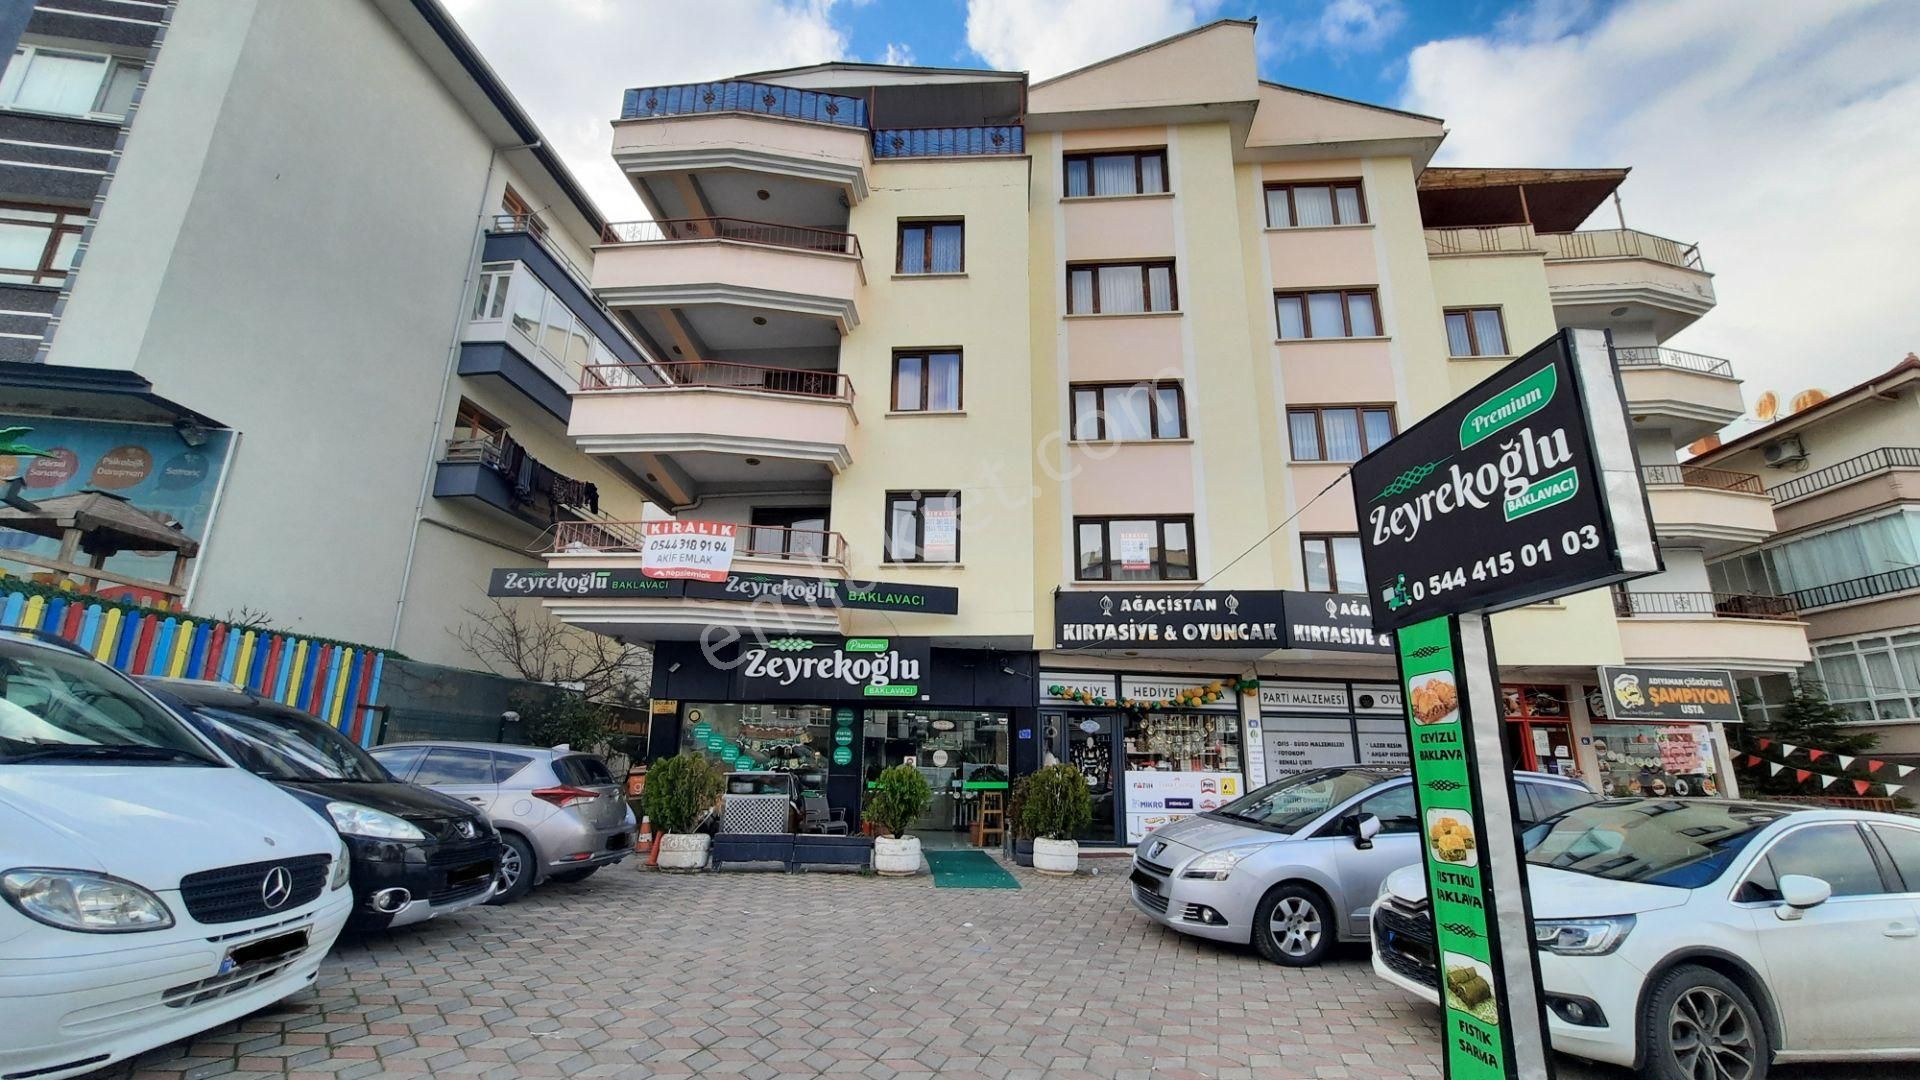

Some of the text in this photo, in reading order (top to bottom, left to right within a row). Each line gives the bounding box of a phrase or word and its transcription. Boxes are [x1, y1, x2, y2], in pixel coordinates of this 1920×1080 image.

[1471, 387, 1543, 433] Premium
[1369, 427, 1574, 546] Zeyrekoğlu
[1507, 477, 1575, 512] BAKLAVACI
[651, 521, 732, 536] KİRALIK
[651, 539, 727, 552] 0544 318 91 94
[656, 553, 713, 565] AKİF EMLAK
[1412, 524, 1600, 600] 0 544 415 01 03
[504, 571, 669, 594] Zeyrekoğlu BAKLAVACI
[725, 576, 925, 606] Zeyrekoğlu BAKLAVACI
[1120, 595, 1217, 615] AĞAÇİSTAN
[1063, 618, 1277, 642] KIRTASİYE & OYUNCAK
[1294, 624, 1391, 648] KIRTASİYE &
[850, 640, 885, 650] Premium
[745, 649, 920, 687] Zeyrekoğlu
[869, 687, 914, 695] BAKLAVACI
[1263, 692, 1345, 705] PARTİ MALZEMESİ
[1648, 687, 1731, 707] ŞAMPİYON
[1681, 705, 1704, 714] USTA
[1420, 749, 1463, 761] BAKLAVA
[1459, 1020, 1492, 1046] FISTIK
[1459, 1039, 1498, 1070] SARMA
